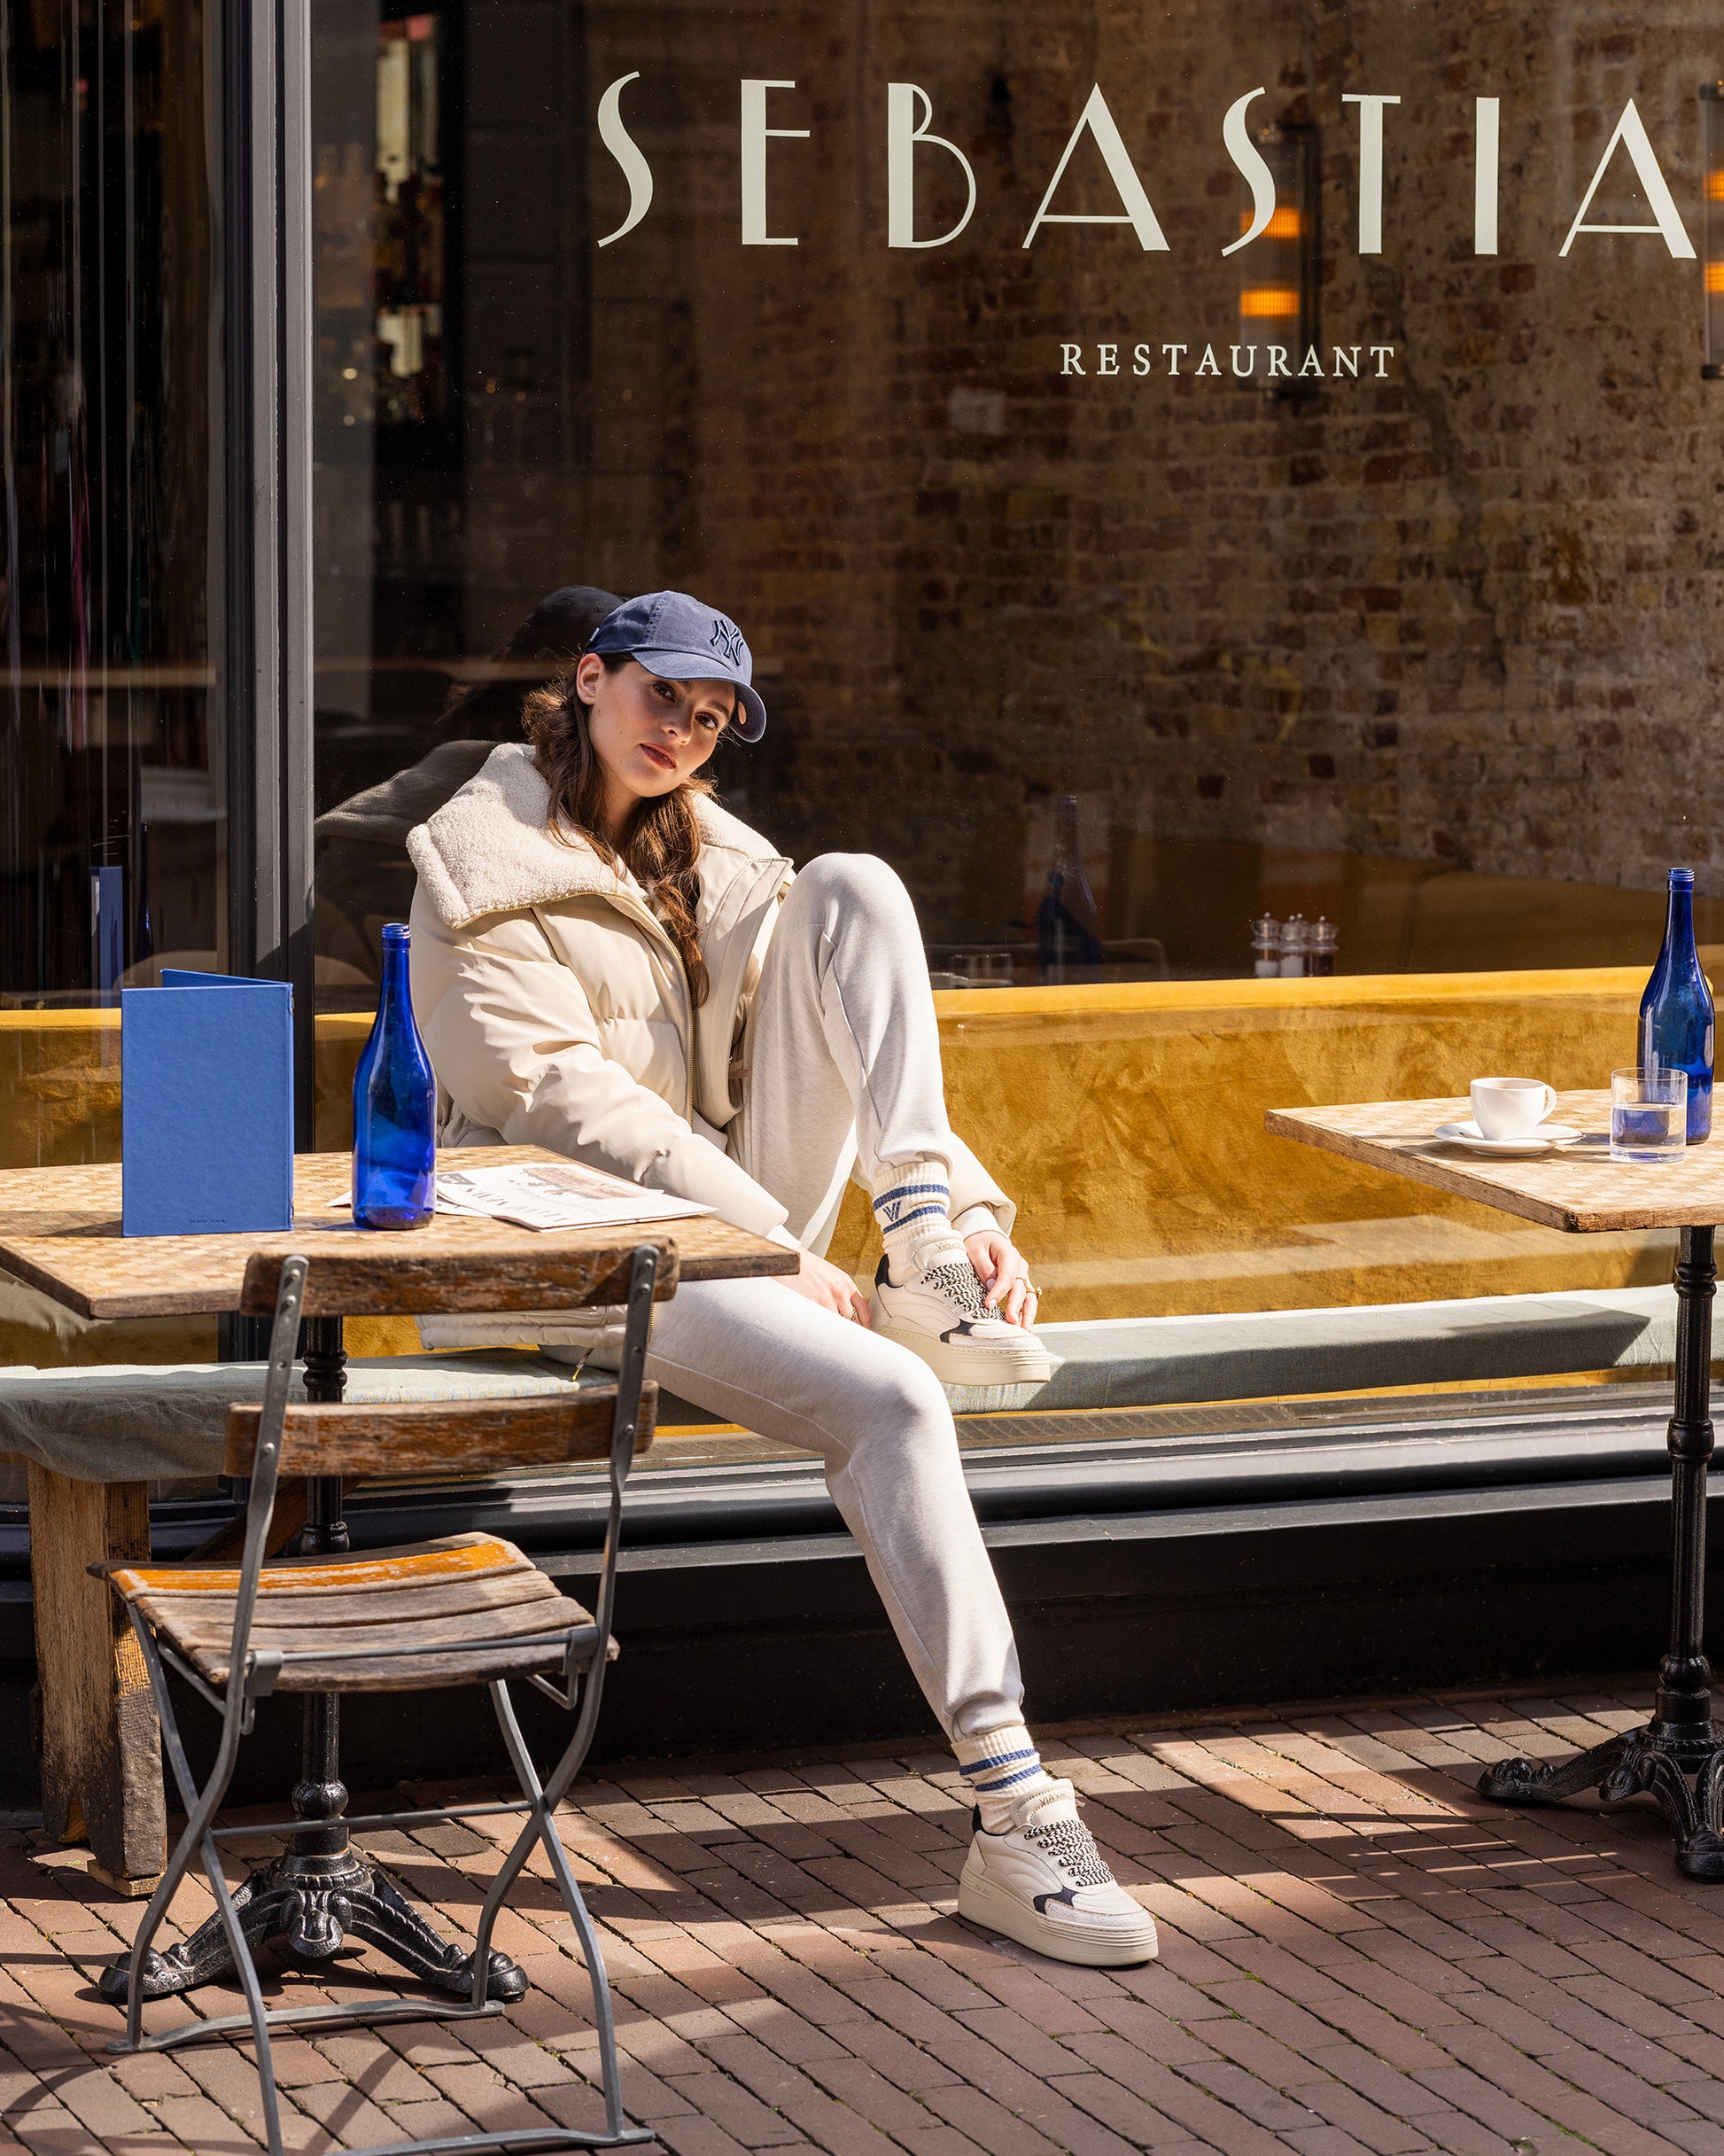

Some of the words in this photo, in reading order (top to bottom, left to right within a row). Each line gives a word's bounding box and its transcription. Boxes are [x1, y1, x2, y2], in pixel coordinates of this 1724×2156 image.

[597, 71, 1697, 259] SEBASTIA
[1060, 342, 1397, 379] RESTAURANT
[710, 618, 743, 666] NY
[1038, 1794, 1055, 1805] VIA
